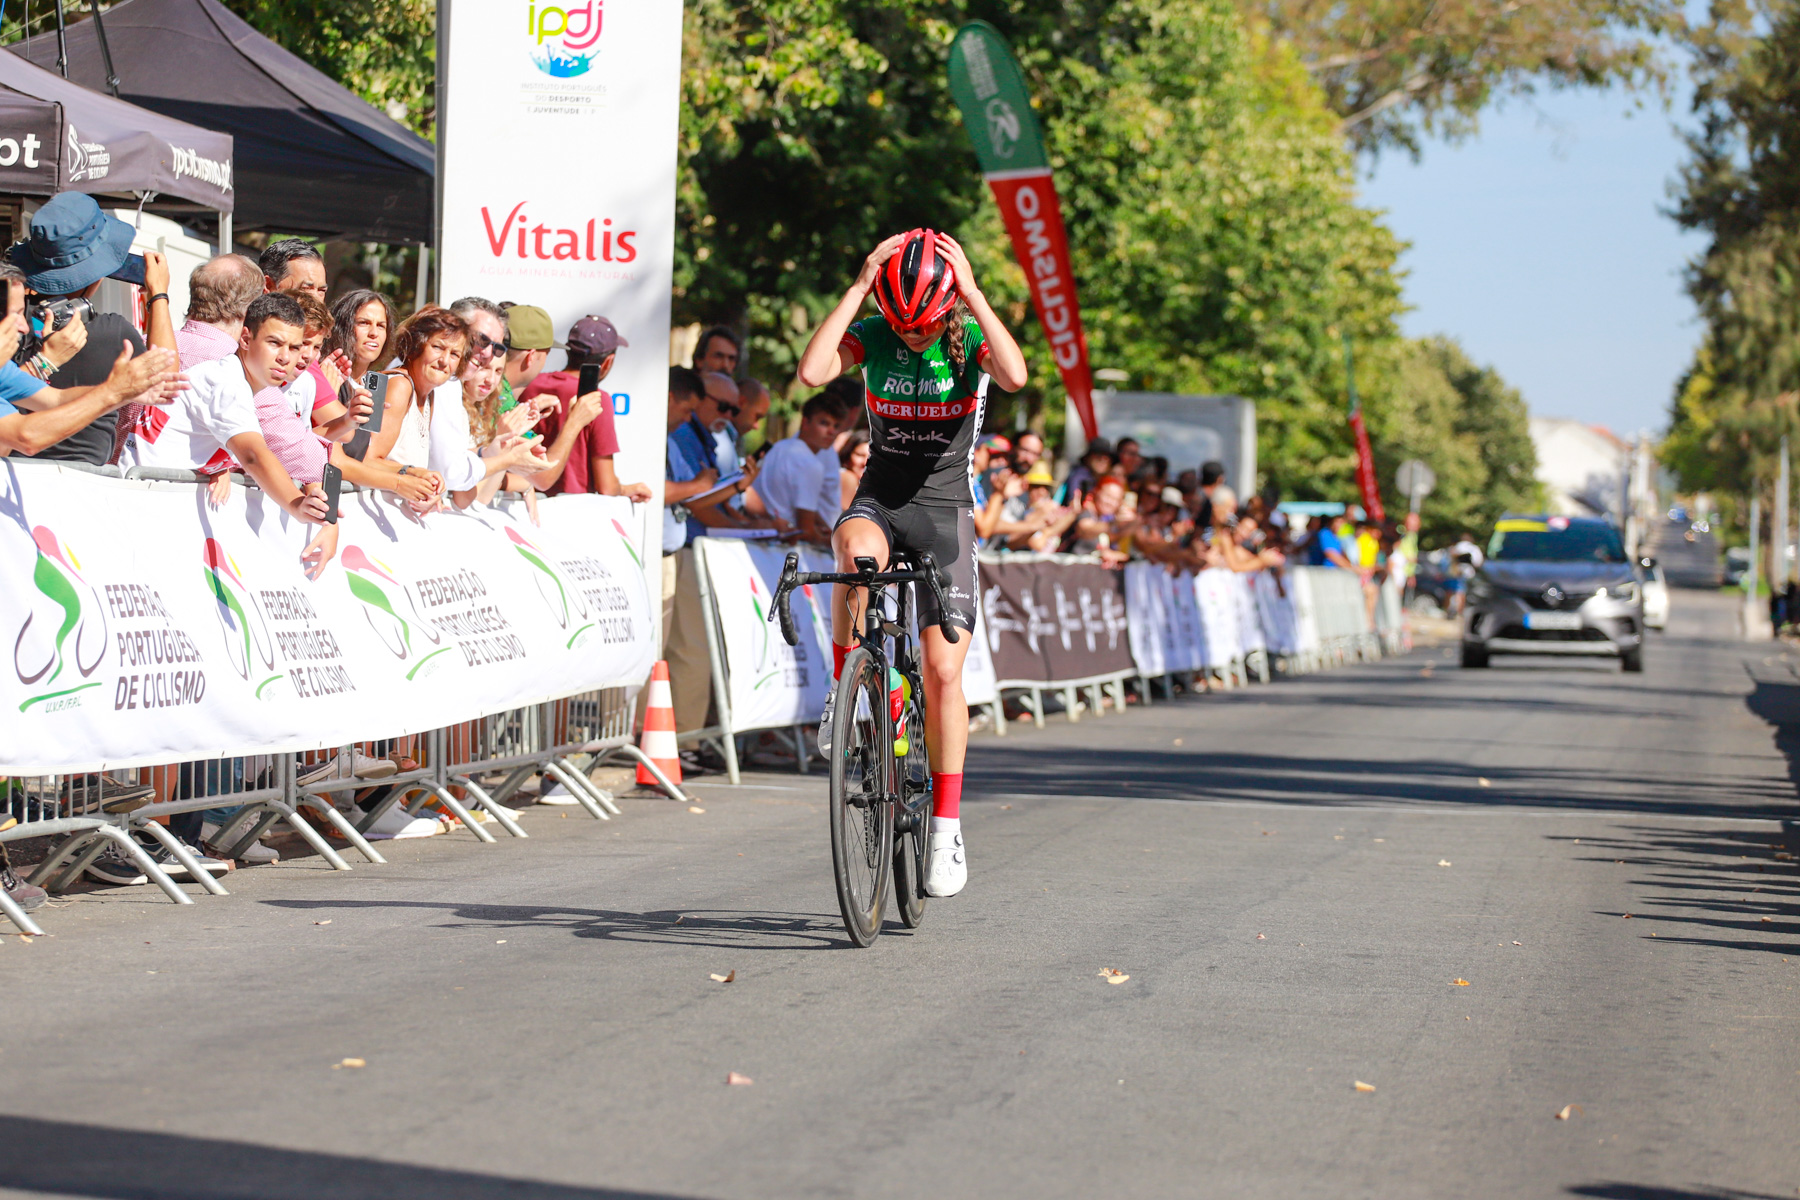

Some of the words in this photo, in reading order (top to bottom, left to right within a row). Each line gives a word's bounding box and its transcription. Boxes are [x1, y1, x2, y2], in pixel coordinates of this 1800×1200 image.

[533, 106, 580, 114] JUVENTUDE
[549, 95, 592, 103] DESPORTO
[481, 200, 638, 263] Vitalis
[518, 268, 573, 278] MINERAL
[579, 271, 637, 281] NATURAL
[876, 401, 962, 418] MERUELO
[887, 427, 951, 444] Spiuk
[416, 568, 486, 608] FEDERAÇÃO
[105, 583, 174, 626] FEDERAÇ
[431, 604, 512, 636] PORTUGUESA
[117, 629, 204, 668] PORTUGUESA
[275, 629, 343, 661] PORTUGUESA
[458, 641, 481, 667] DE
[473, 634, 526, 664] CICLISMO
[114, 675, 139, 710] DE
[143, 670, 206, 709] CICLISMO
[289, 668, 311, 698] DE
[307, 665, 356, 697] CICLISMO
